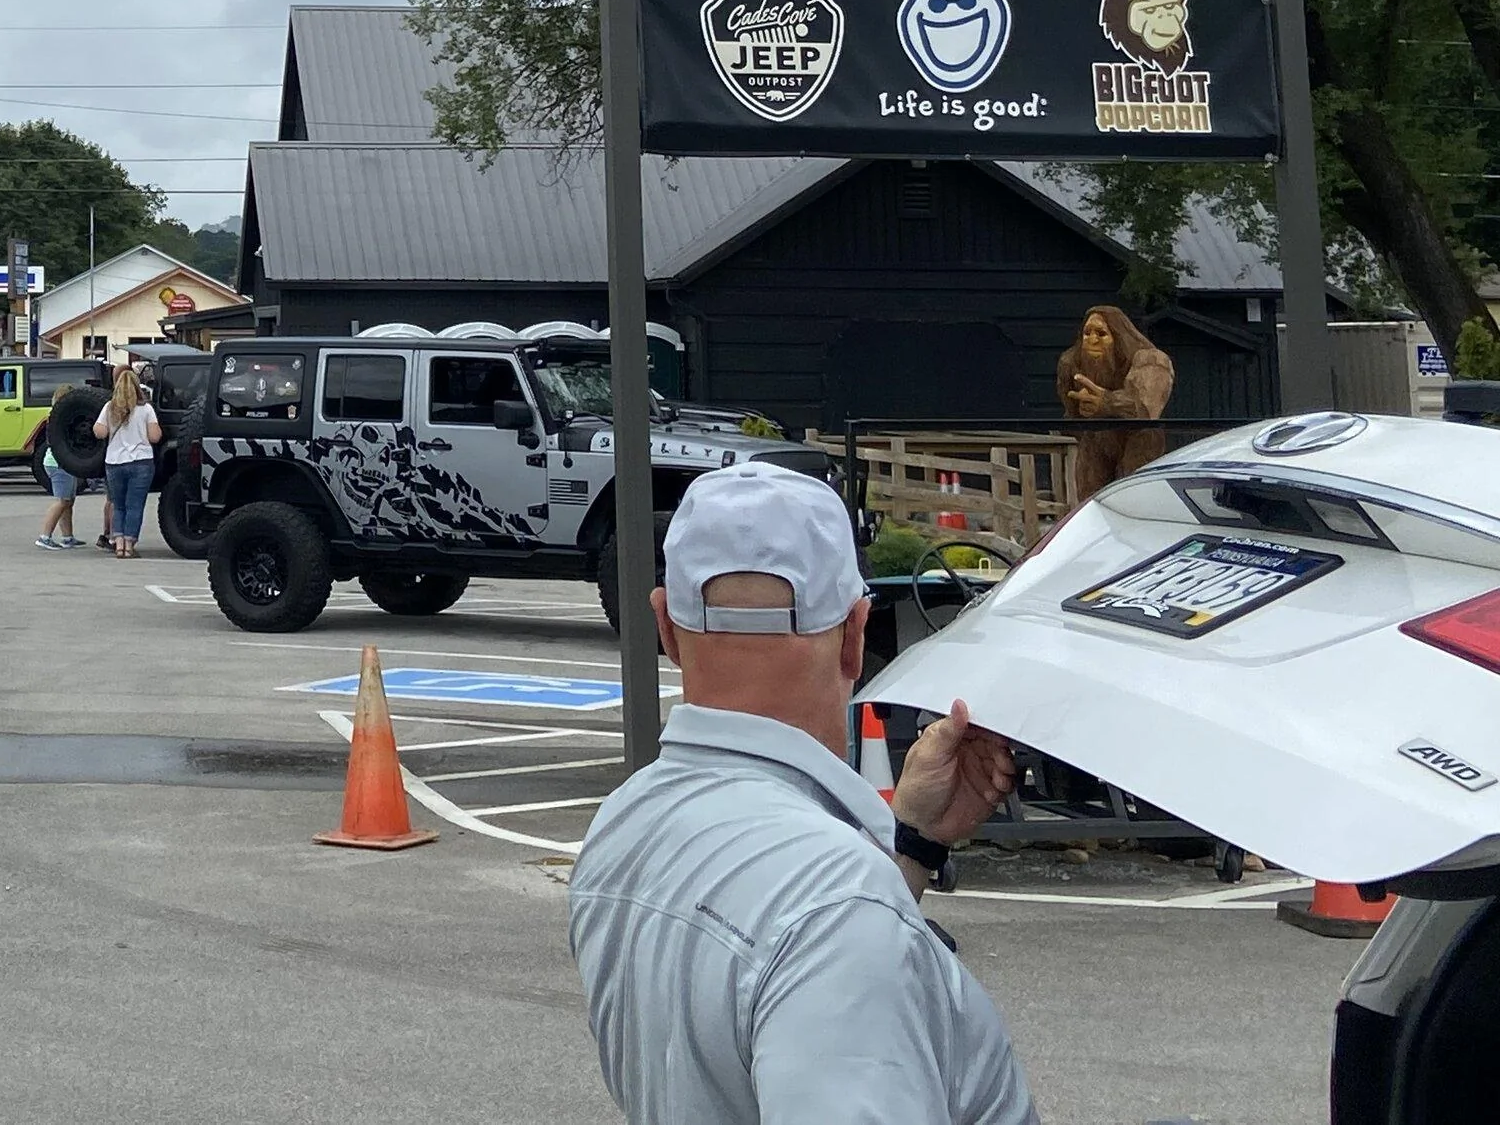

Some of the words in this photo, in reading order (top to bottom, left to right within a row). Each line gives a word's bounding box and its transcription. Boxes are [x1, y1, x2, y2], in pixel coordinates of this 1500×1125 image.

[731, 46, 821, 71] JEEP
[748, 77, 804, 87] OUTPOST
[1093, 63, 1211, 104] BIGFOOT
[878, 90, 934, 118] Life
[941, 95, 966, 116] is
[1097, 104, 1212, 133] POPCORN
[1407, 746, 1482, 781] AWD
